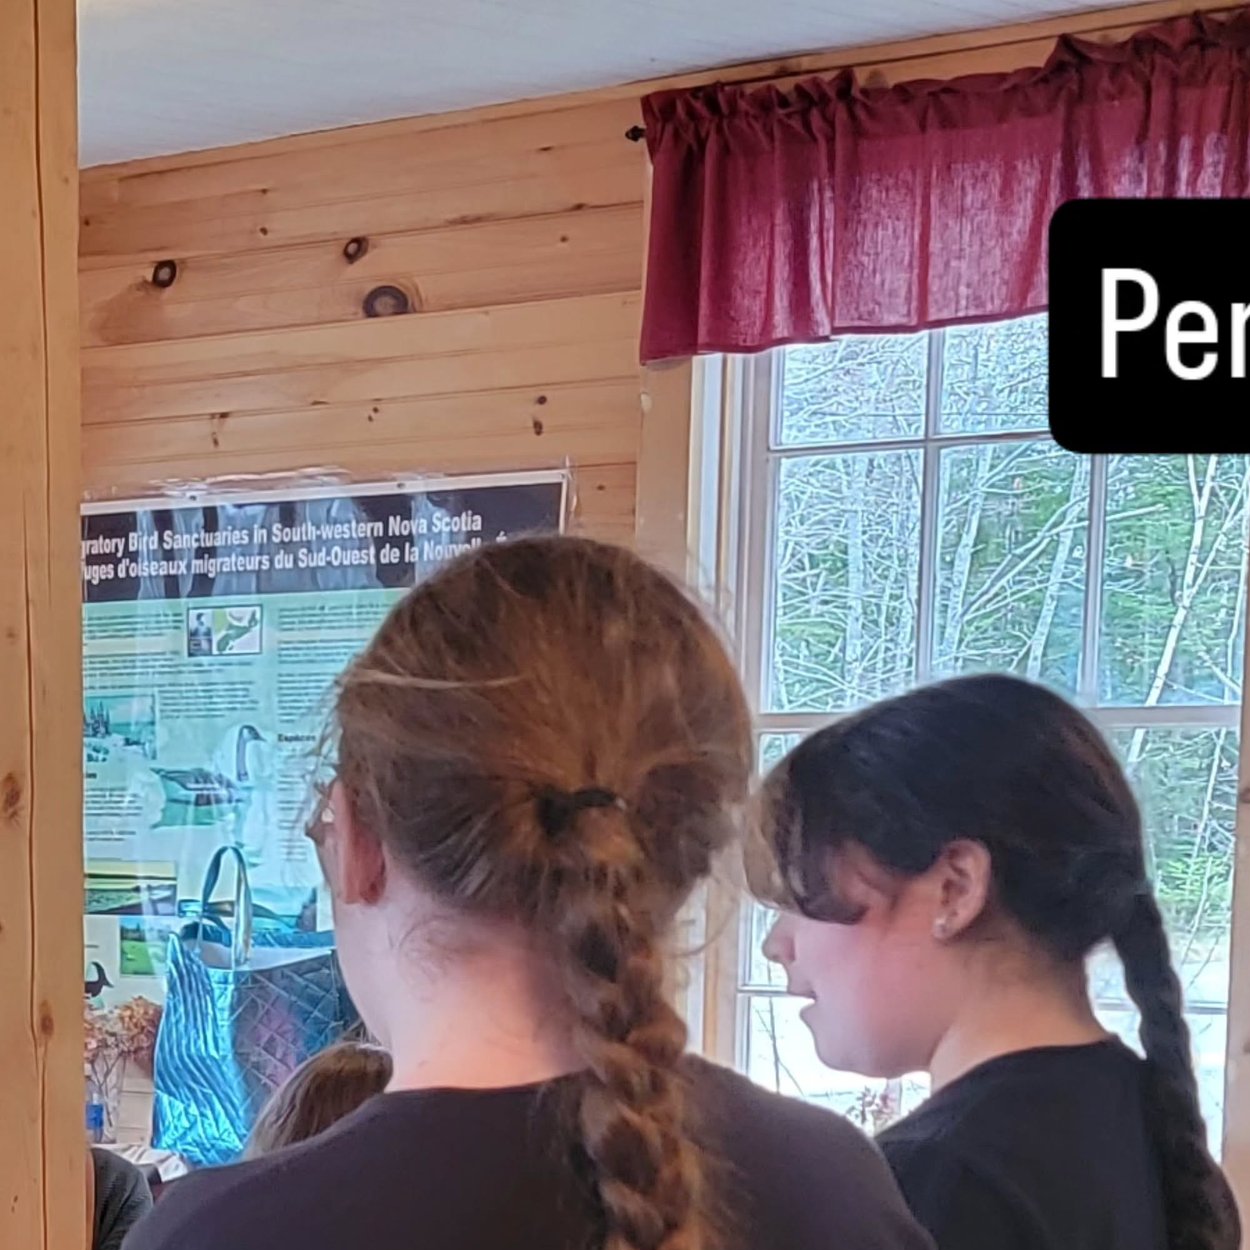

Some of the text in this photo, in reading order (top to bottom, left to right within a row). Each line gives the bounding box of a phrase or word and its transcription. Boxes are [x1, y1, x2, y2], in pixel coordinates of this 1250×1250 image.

[129, 531, 158, 551] Bird
[163, 526, 249, 550] Sanctuaries
[253, 524, 267, 545] in
[272, 519, 383, 543] South-western
[388, 515, 427, 537] Nova
[432, 510, 482, 533] Scotia
[118, 556, 187, 579] d'oiseaux
[192, 553, 270, 579] migrateurs
[275, 550, 294, 569] du
[298, 545, 376, 568] Sud-Ouest
[380, 543, 399, 564] de
[405, 542, 419, 563] la
[424, 537, 483, 562] Nouvll
